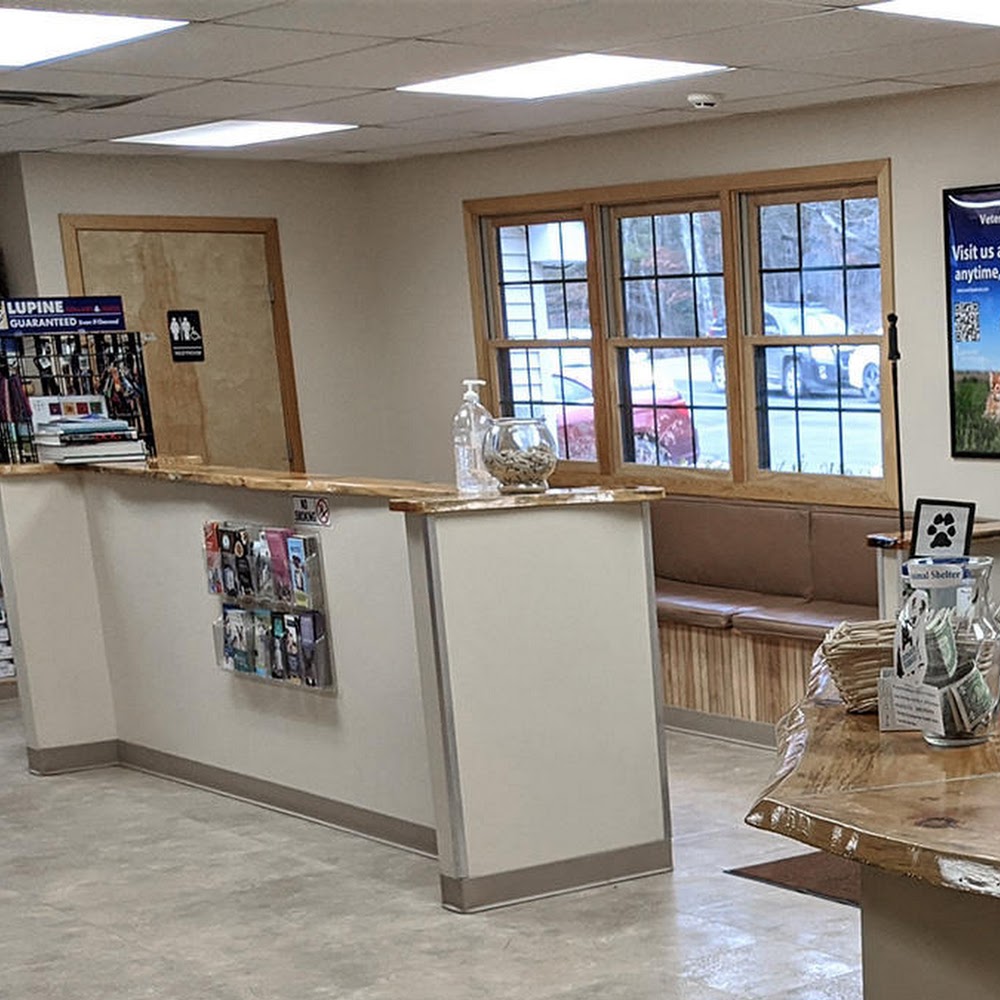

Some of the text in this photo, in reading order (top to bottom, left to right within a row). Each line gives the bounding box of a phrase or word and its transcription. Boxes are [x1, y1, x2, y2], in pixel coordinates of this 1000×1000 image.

[952, 243, 978, 261] Visit
[980, 246, 995, 259] us
[6, 300, 65, 315] LUPINE
[9, 317, 77, 328] GUARANTEED
[931, 569, 961, 579] Shelter
